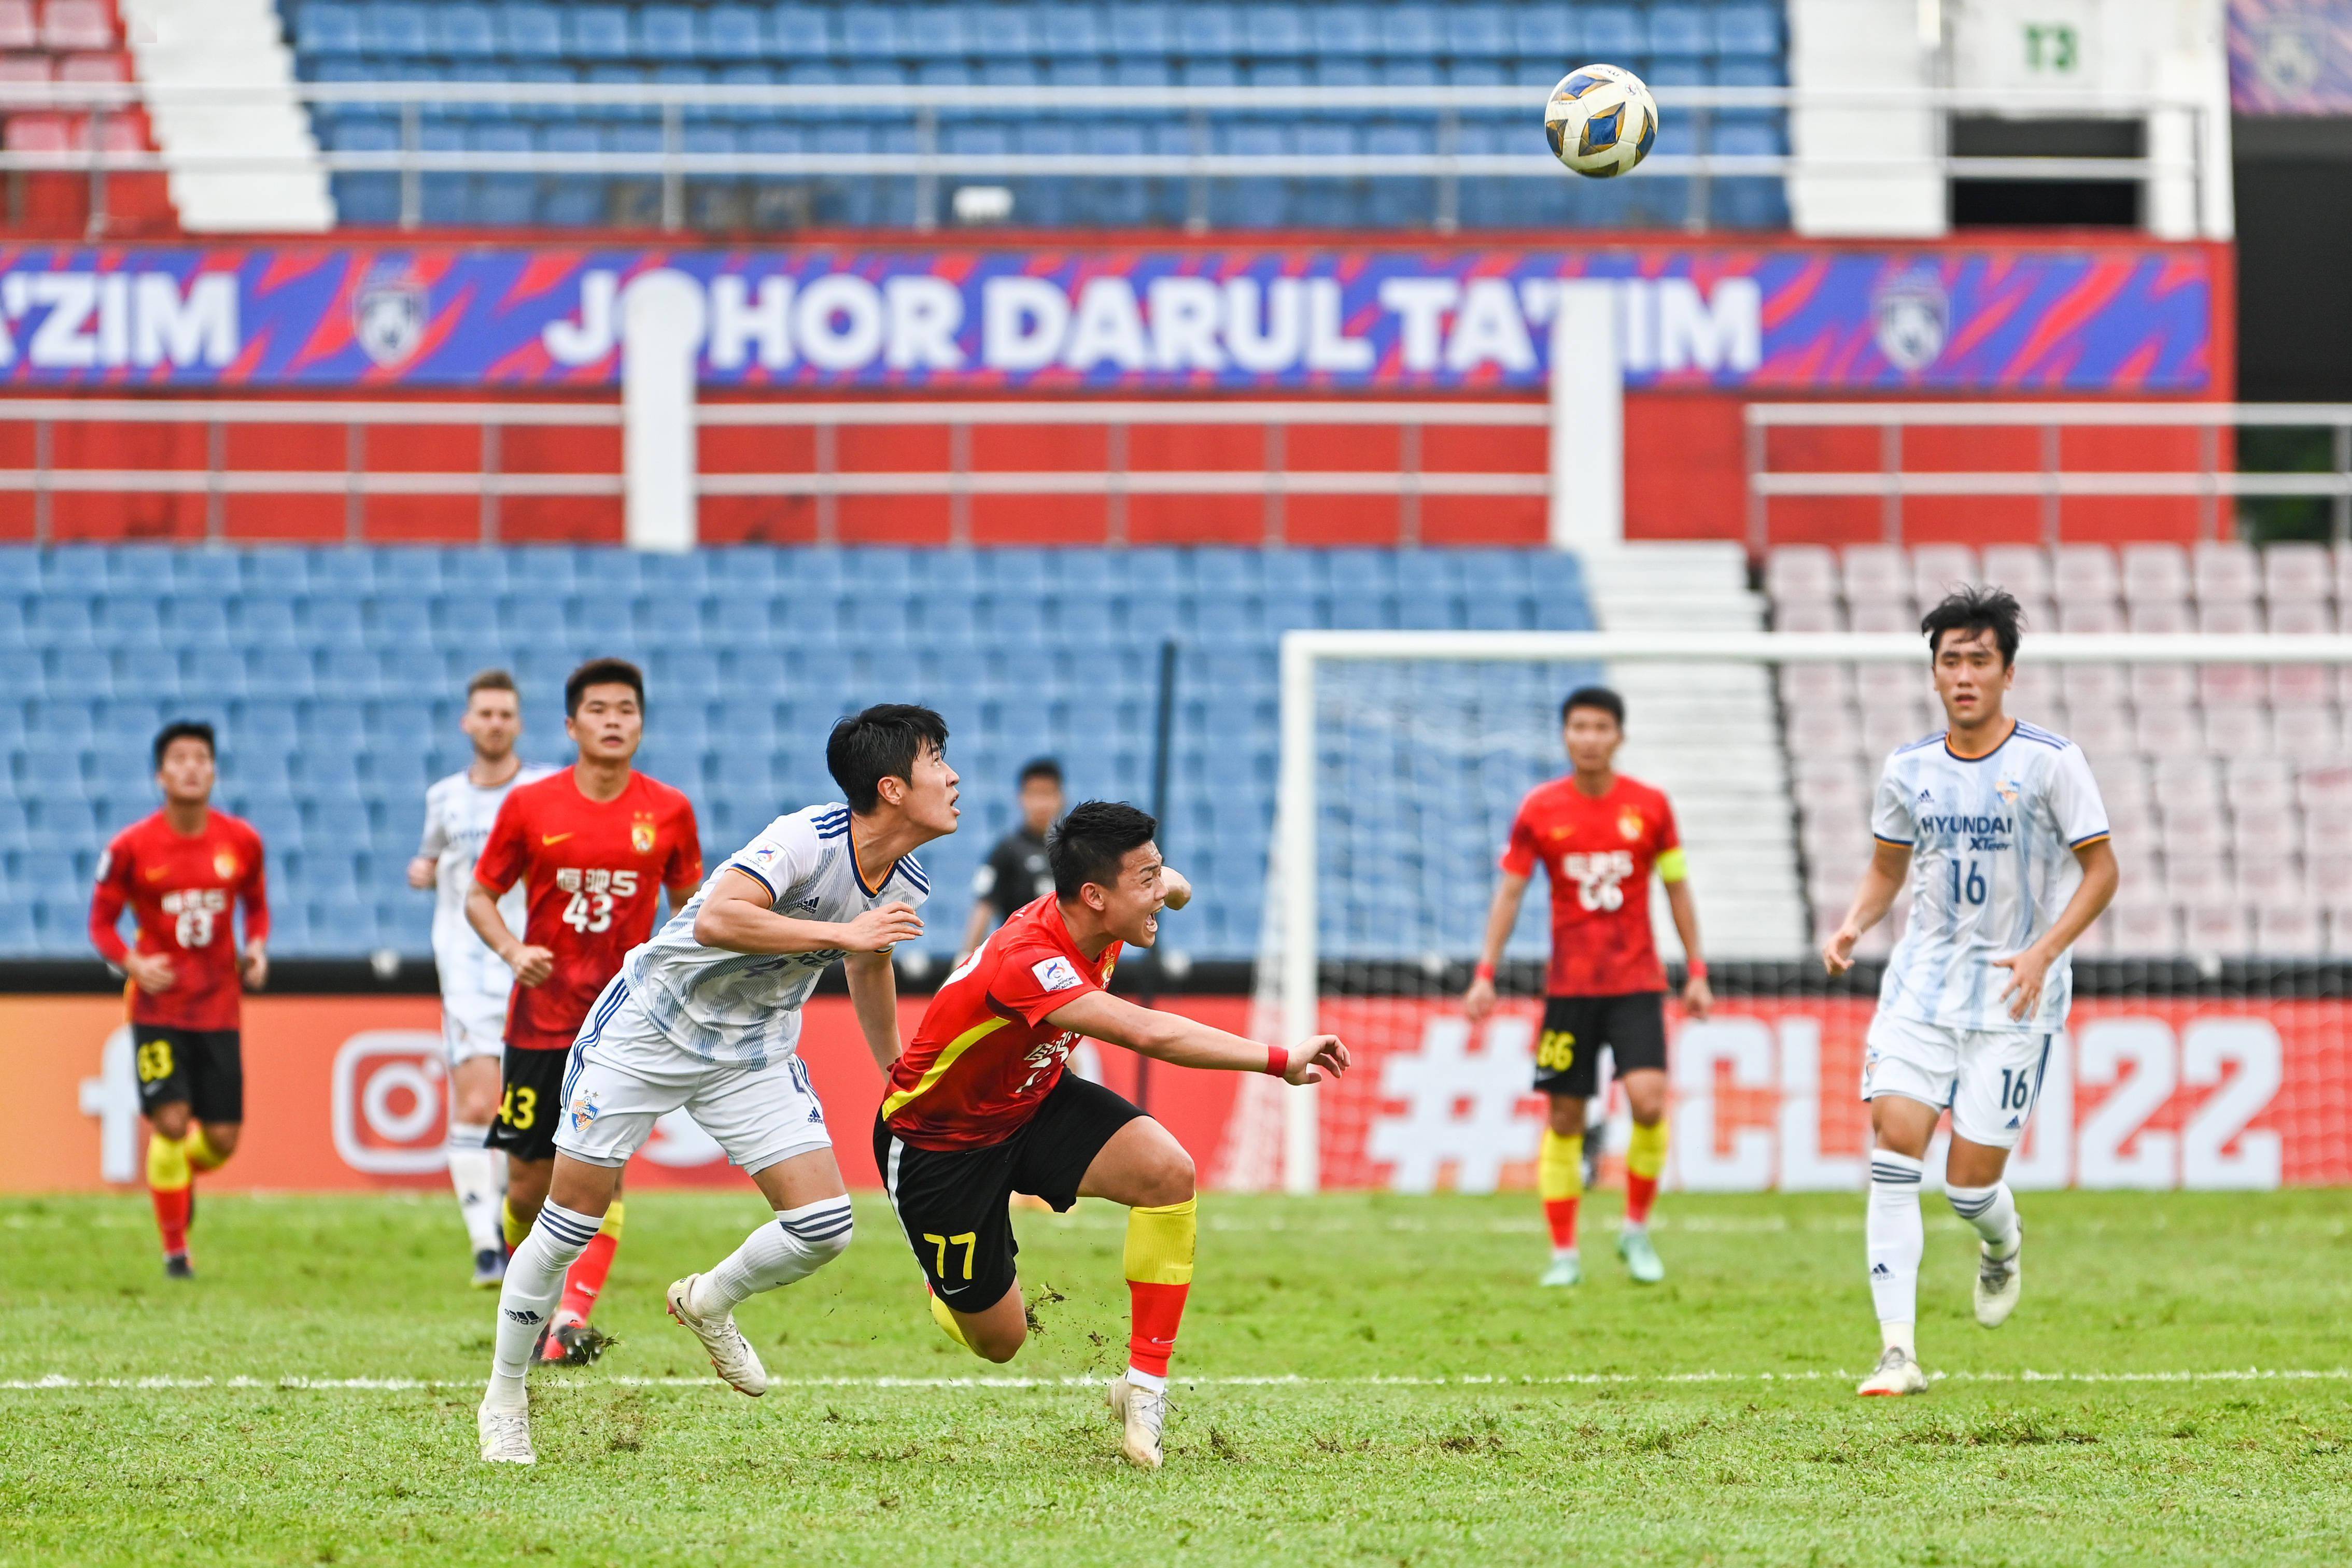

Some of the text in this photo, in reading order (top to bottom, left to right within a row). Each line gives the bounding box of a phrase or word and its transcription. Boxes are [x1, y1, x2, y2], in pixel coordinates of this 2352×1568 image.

[0, 270, 238, 368] 'ZIM
[982, 275, 1375, 371] DARUL
[1378, 276, 1763, 372] TA'IM
[1921, 816, 2012, 834] HYUNDAI
[1952, 860, 1987, 906] 16
[562, 892, 613, 934] 43
[797, 902, 816, 914] adidas
[498, 1087, 537, 1130] 43
[2002, 1068, 2027, 1109] 16
[923, 1232, 976, 1279] 77
[504, 1308, 544, 1325] adidas
